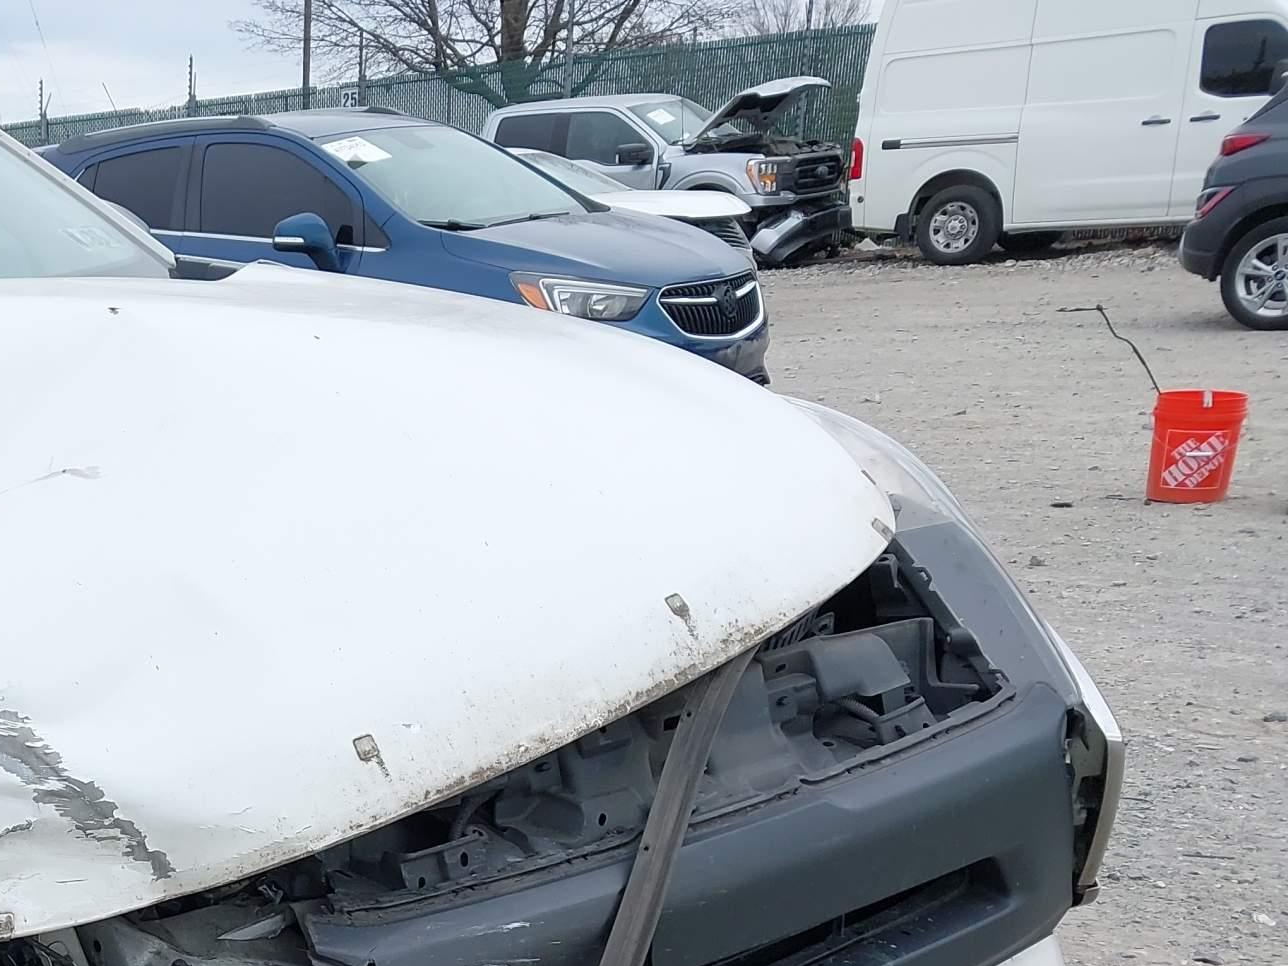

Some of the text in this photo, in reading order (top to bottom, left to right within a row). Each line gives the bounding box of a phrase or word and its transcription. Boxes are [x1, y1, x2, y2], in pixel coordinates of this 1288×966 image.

[342, 92, 357, 107] 25
[1161, 431, 1229, 487] HOME
[1184, 454, 1226, 489] DEPOT
